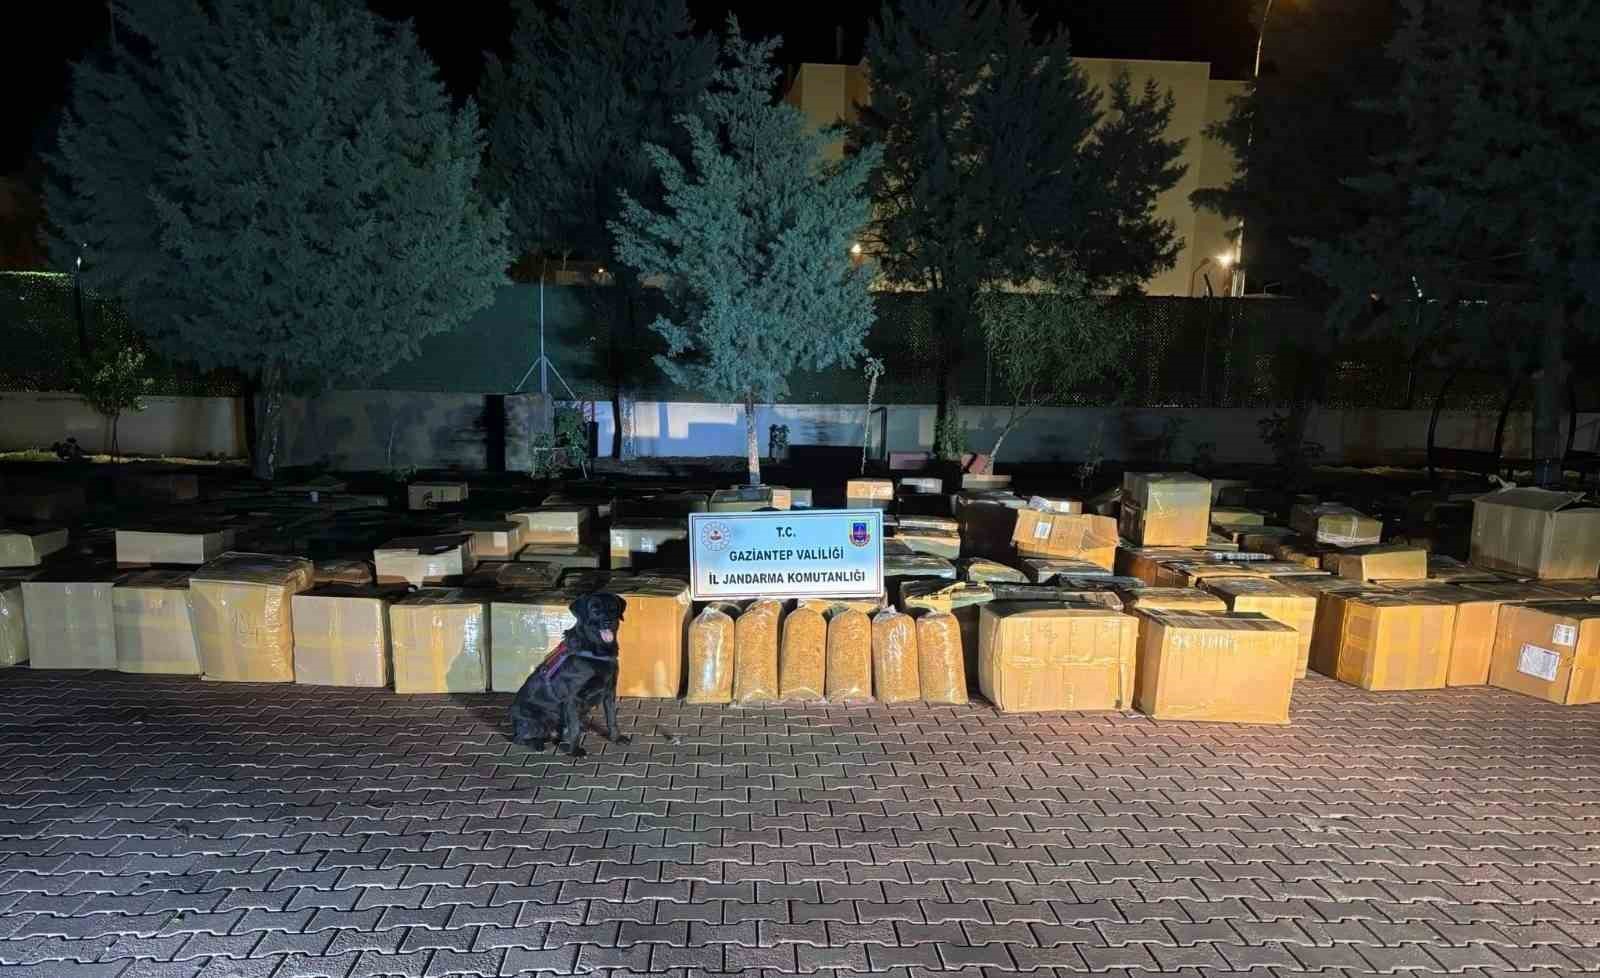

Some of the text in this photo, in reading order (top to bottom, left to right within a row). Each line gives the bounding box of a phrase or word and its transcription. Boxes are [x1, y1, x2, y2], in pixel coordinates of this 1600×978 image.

[776, 526, 796, 538] T.C.
[729, 547, 844, 562] GAZİANTEP VALİLİĞİ
[709, 568, 865, 585] İL JANDARMA KOMUTANLIĞI
